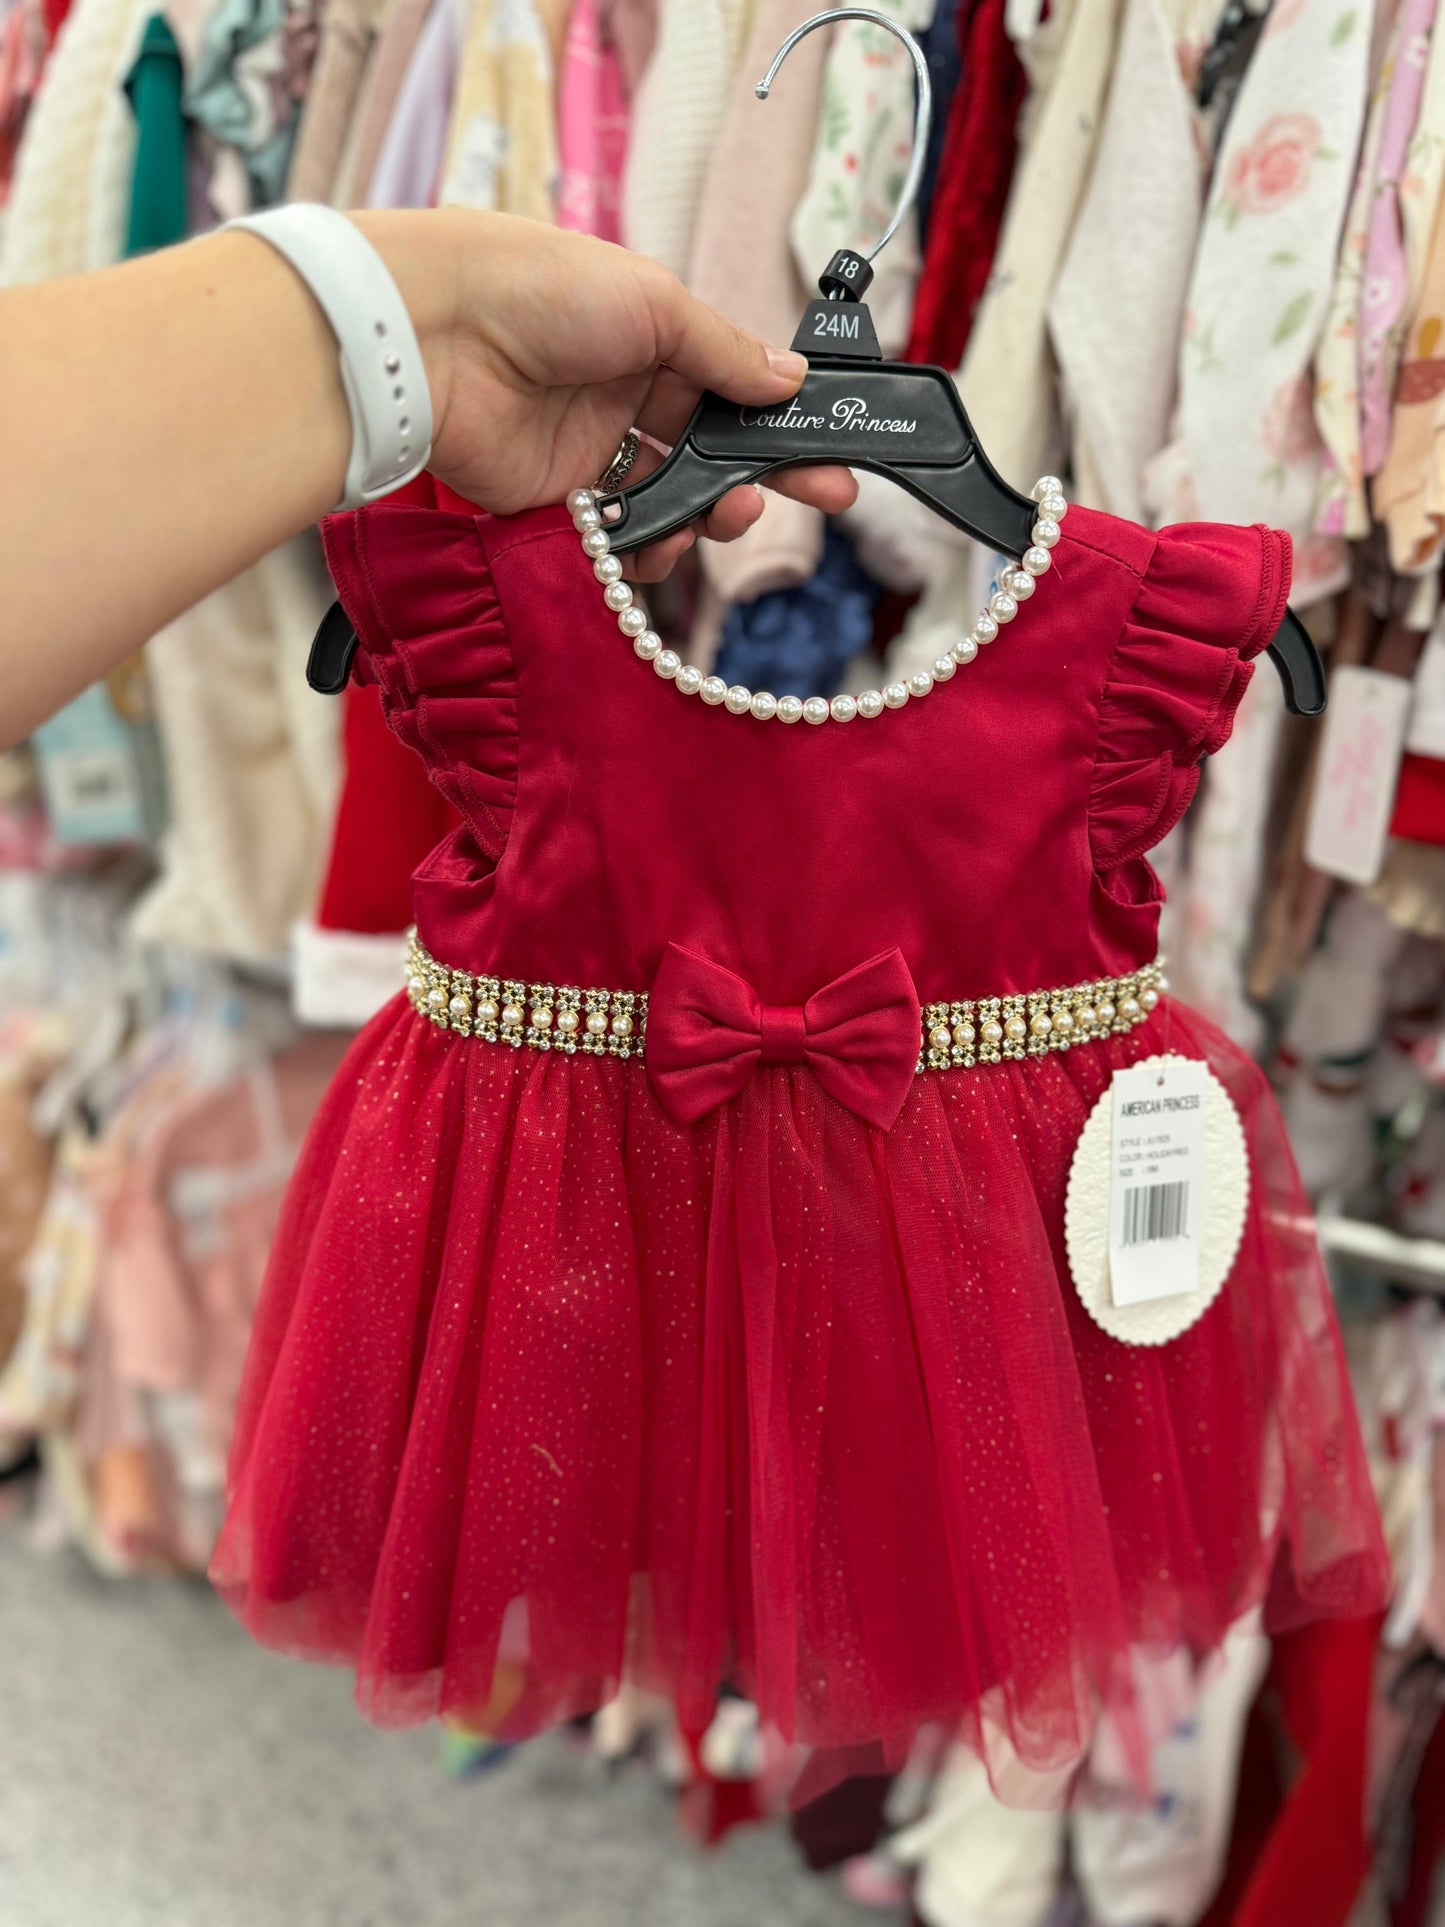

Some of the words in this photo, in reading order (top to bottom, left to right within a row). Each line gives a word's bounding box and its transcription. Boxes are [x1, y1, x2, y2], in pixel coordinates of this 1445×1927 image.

[838, 257, 859, 279] 18
[814, 313, 859, 339] 24M
[829, 397, 917, 433] Princess
[1121, 1100, 1161, 1116] AMERICAN
[1163, 1095, 1200, 1111] PRINCESS
